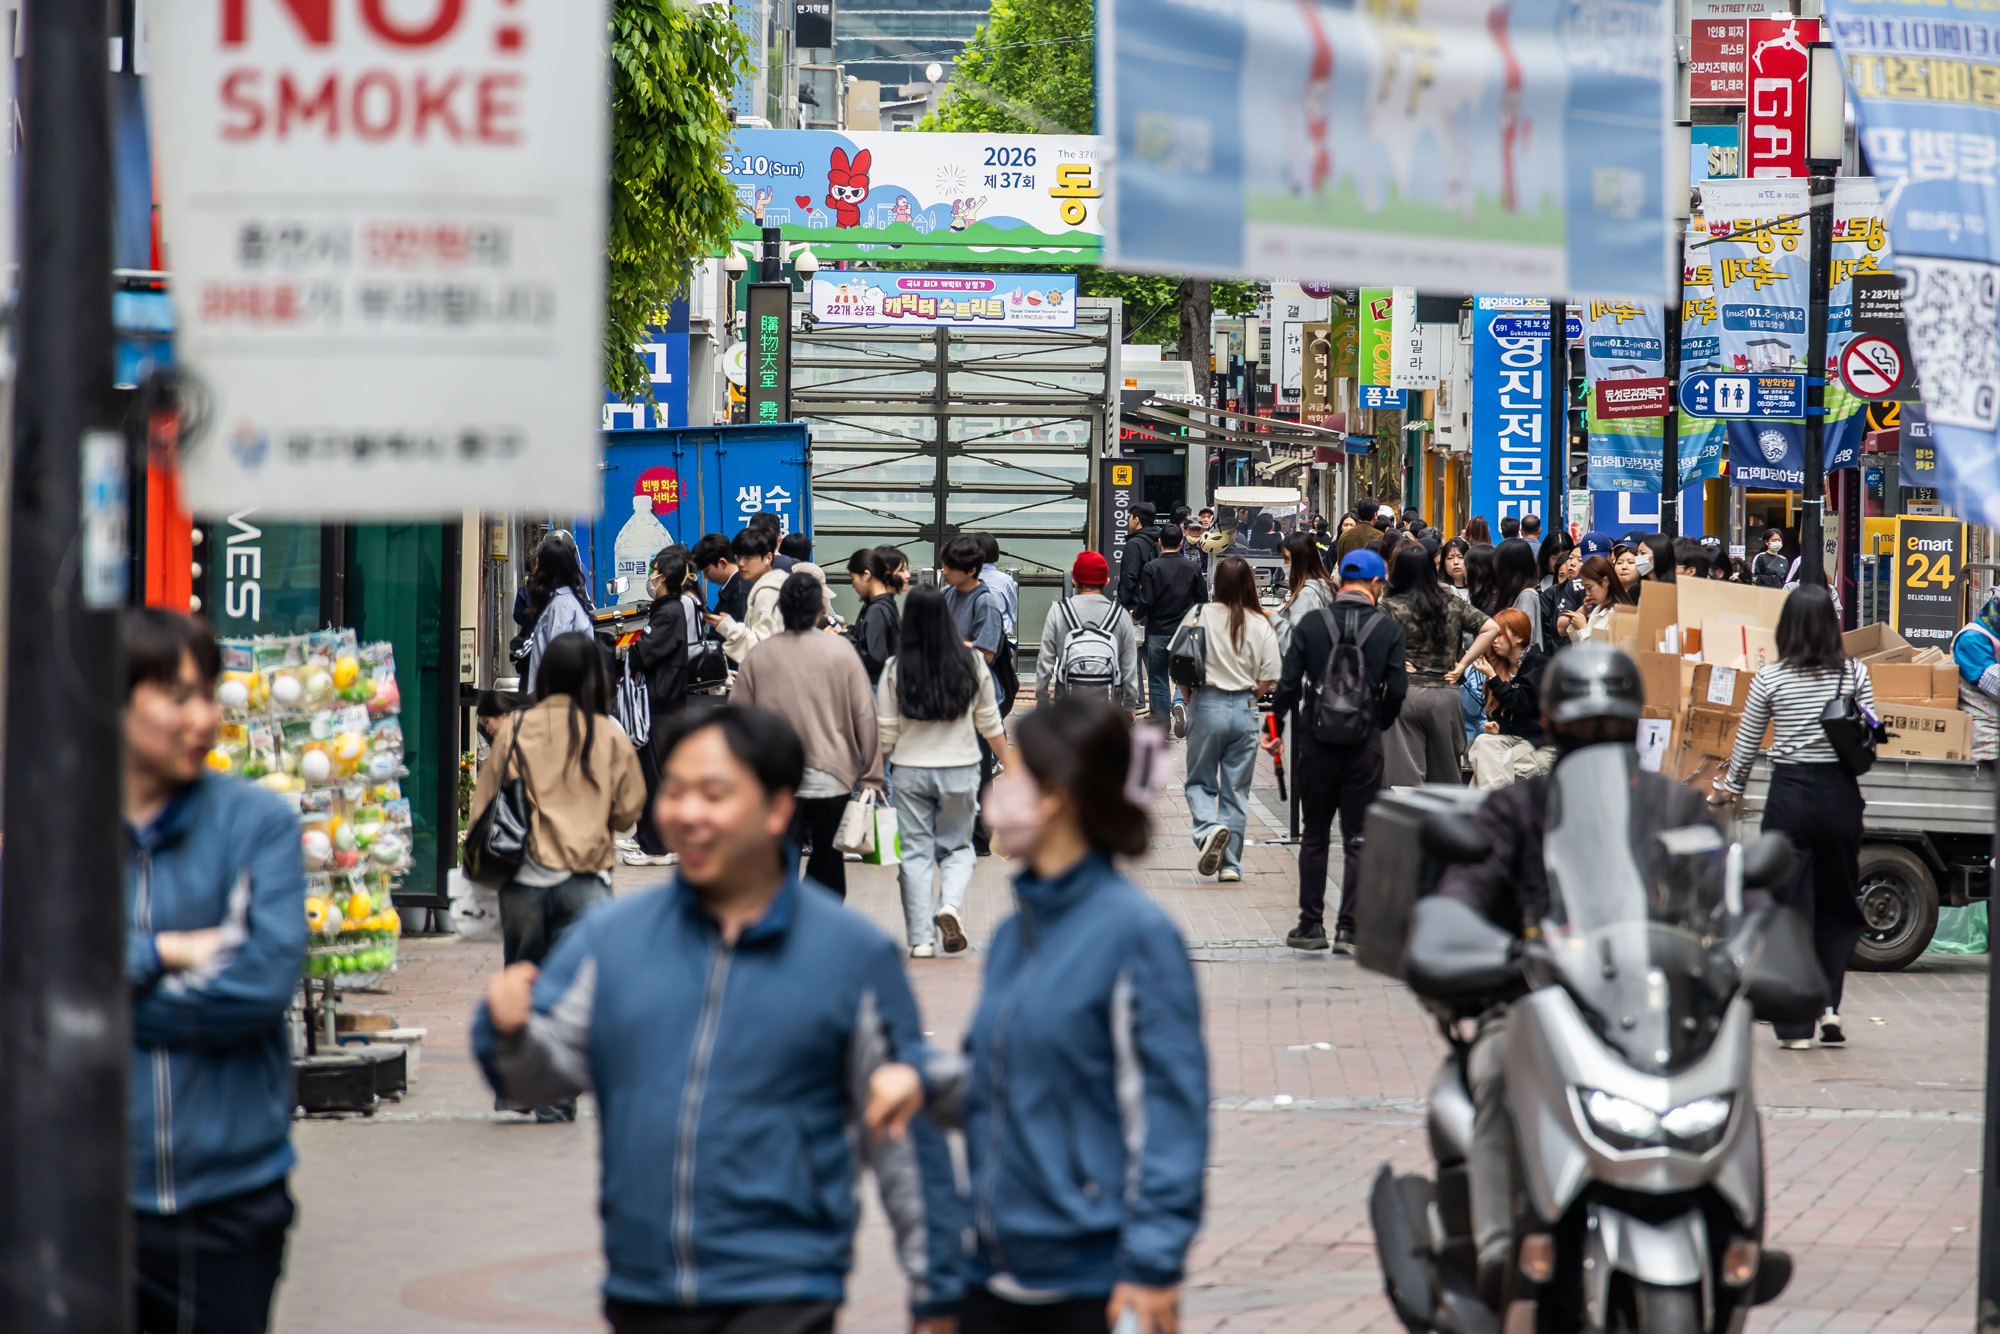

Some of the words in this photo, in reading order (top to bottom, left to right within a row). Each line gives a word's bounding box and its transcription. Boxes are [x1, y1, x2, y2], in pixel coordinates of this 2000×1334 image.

[1707, 4, 1719, 13] 7TH
[1721, 4, 1745, 13] STREET
[1746, 3, 1765, 12] PIZZA
[1707, 26, 1726, 38] 1인용
[1728, 26, 1744, 37] 피자
[1720, 44, 1744, 55] 파스타
[218, 68, 526, 146] SMOKE
[1753, 78, 1792, 178] GA
[983, 147, 1037, 167] 2026
[1058, 150, 1076, 159] The
[1708, 146, 1738, 176] STR
[719, 155, 804, 178] 5.10(Sun)
[984, 174, 997, 189] 제
[1000, 172, 1035, 189] 37회
[1049, 163, 1104, 229] 동
[906, 280, 922, 289] 국내
[940, 280, 963, 289] 캐릭터
[964, 281, 986, 290] 상점가
[1860, 289, 1900, 300] 2·28기념
[826, 304, 851, 316] 22개
[854, 304, 876, 317] 상점
[884, 293, 937, 319] 캐릭터
[938, 297, 1004, 320] 스트리트
[1495, 324, 1508, 332] 591
[1514, 320, 1551, 329] 국채보상
[1566, 324, 1580, 332] 595
[760, 315, 779, 388] 購物天堂
[1313, 353, 1328, 397] 럭셔리
[1758, 378, 1796, 387] 개방화장실
[1605, 386, 1666, 403] 동성로관광특구
[1307, 402, 1333, 412] 귀금속
[1867, 473, 1881, 481] ADT
[642, 479, 661, 493] 빈병
[661, 479, 679, 492] 회수
[652, 492, 679, 504] 서비스
[735, 485, 792, 513] 생수
[1907, 537, 1953, 552] emart
[618, 561, 647, 575] 스파클
[1906, 553, 1956, 590] 24
[1907, 594, 1938, 602] DELICIOUS
[1938, 594, 1952, 602] IDEA
